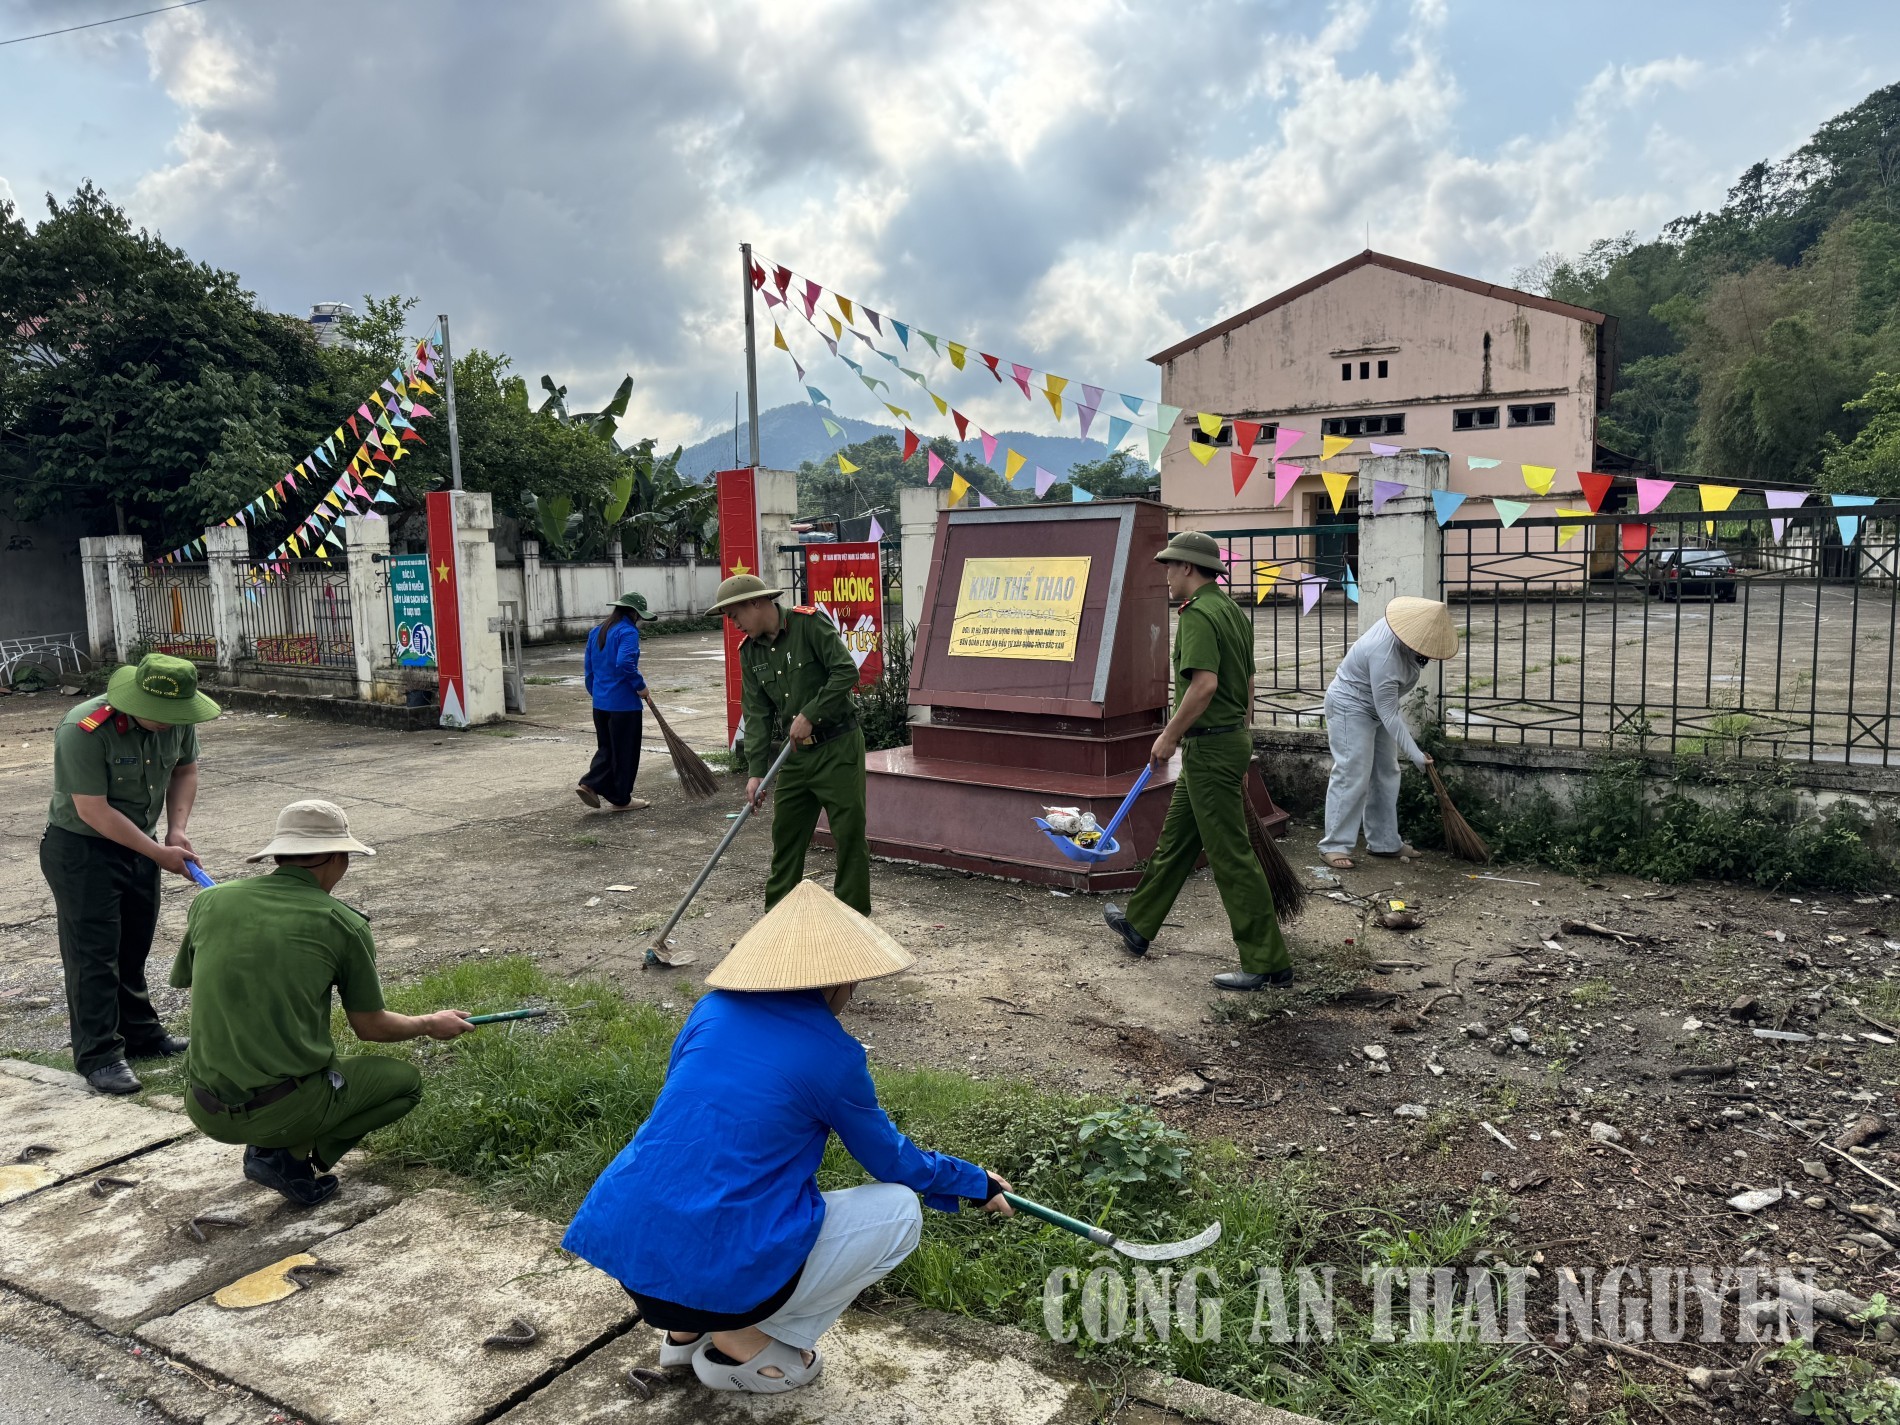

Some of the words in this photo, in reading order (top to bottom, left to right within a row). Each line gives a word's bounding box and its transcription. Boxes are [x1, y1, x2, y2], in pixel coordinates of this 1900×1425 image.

[814, 588, 832, 602] NÓI
[833, 571, 874, 602] KHÔNG
[968, 576, 1000, 601] KHU
[1002, 566, 1035, 601] THỂ
[1034, 576, 1076, 601] THAO
[837, 606, 851, 617] VỚI
[843, 627, 881, 653] TÚY
